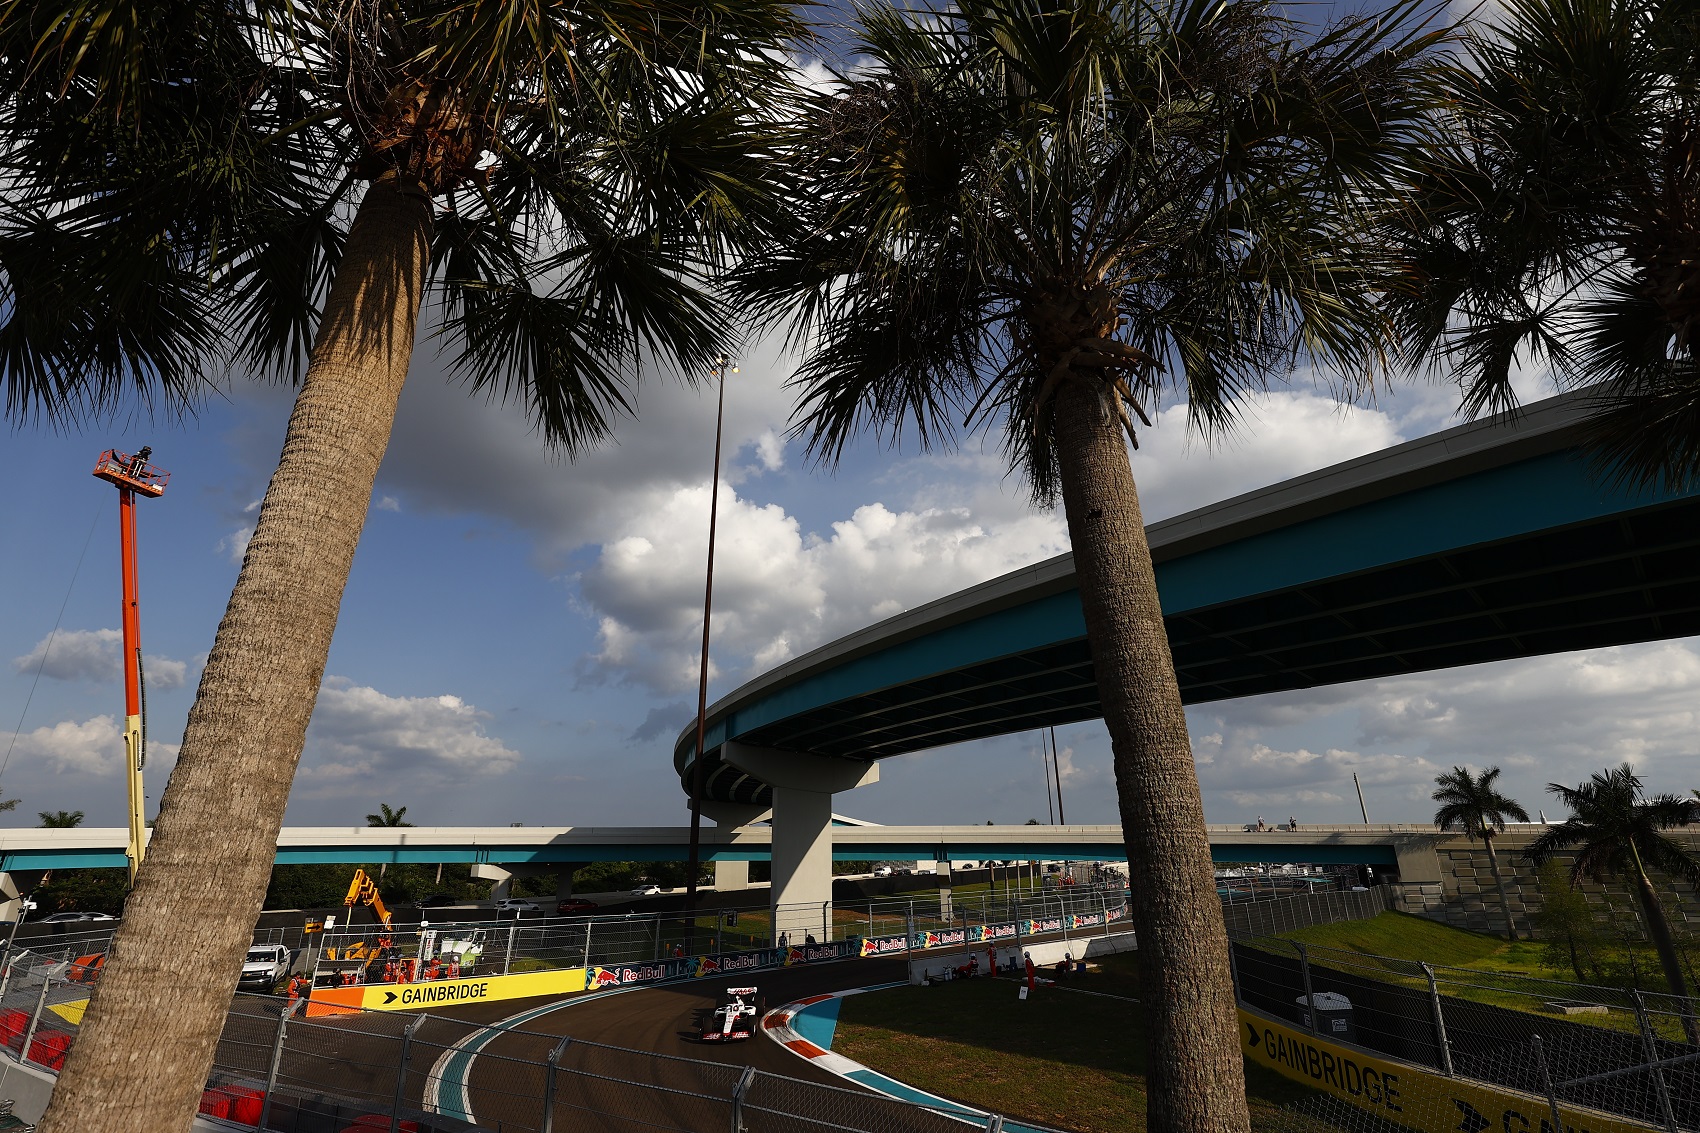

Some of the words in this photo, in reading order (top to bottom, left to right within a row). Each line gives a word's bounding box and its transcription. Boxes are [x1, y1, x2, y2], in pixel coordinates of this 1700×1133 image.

[879, 939, 893, 951] Red
[893, 937, 907, 949] Bull
[941, 932, 953, 944] Red
[953, 930, 965, 942] Bull
[723, 956, 741, 970] Red
[741, 953, 760, 968] Bull
[807, 948, 823, 961] Red
[823, 945, 839, 958] Bull
[622, 968, 644, 983] Red
[644, 964, 666, 980] Bull
[402, 983, 488, 1004] GAINBRIDGE
[1263, 1029, 1403, 1112] GAINBRIDGE
